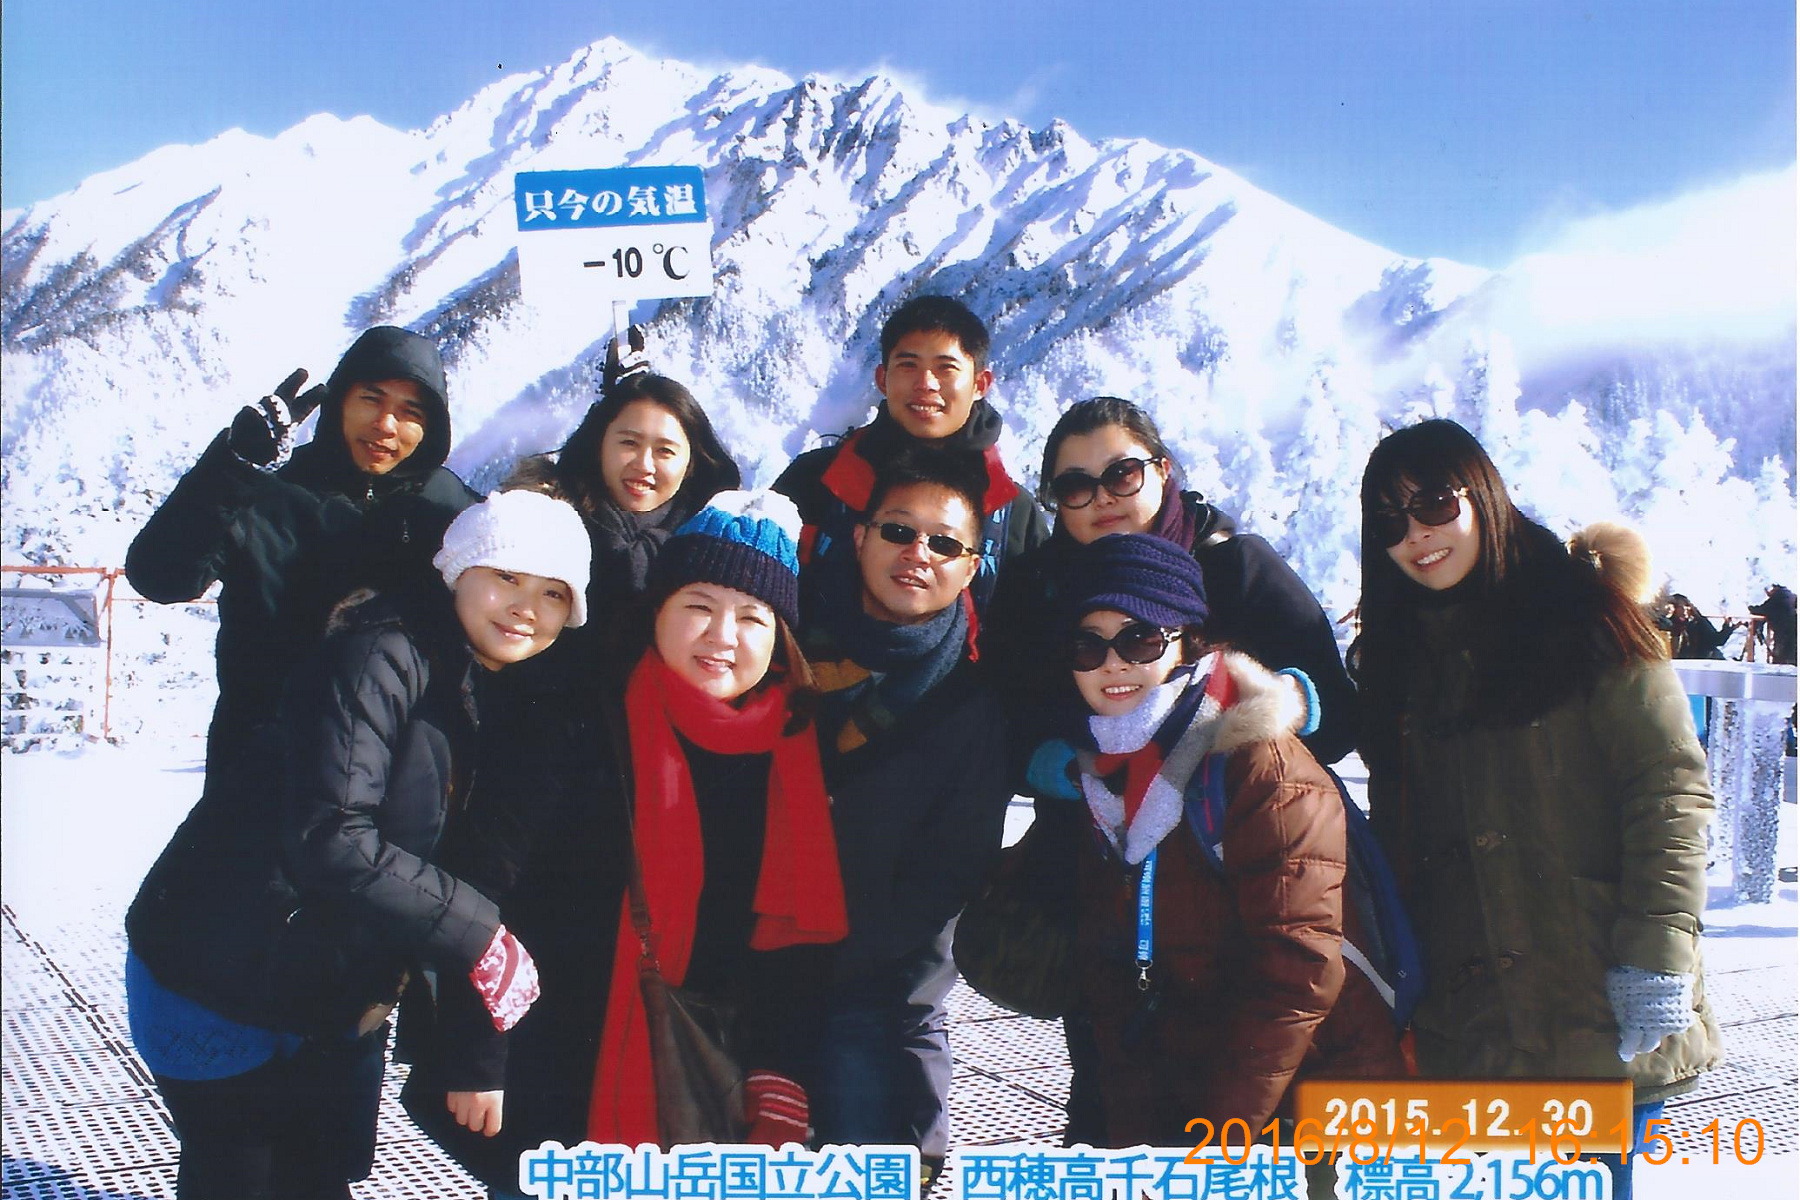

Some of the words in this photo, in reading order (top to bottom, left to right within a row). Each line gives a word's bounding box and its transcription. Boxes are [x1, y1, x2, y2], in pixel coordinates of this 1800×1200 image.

[524, 184, 698, 222] 只今の気温
